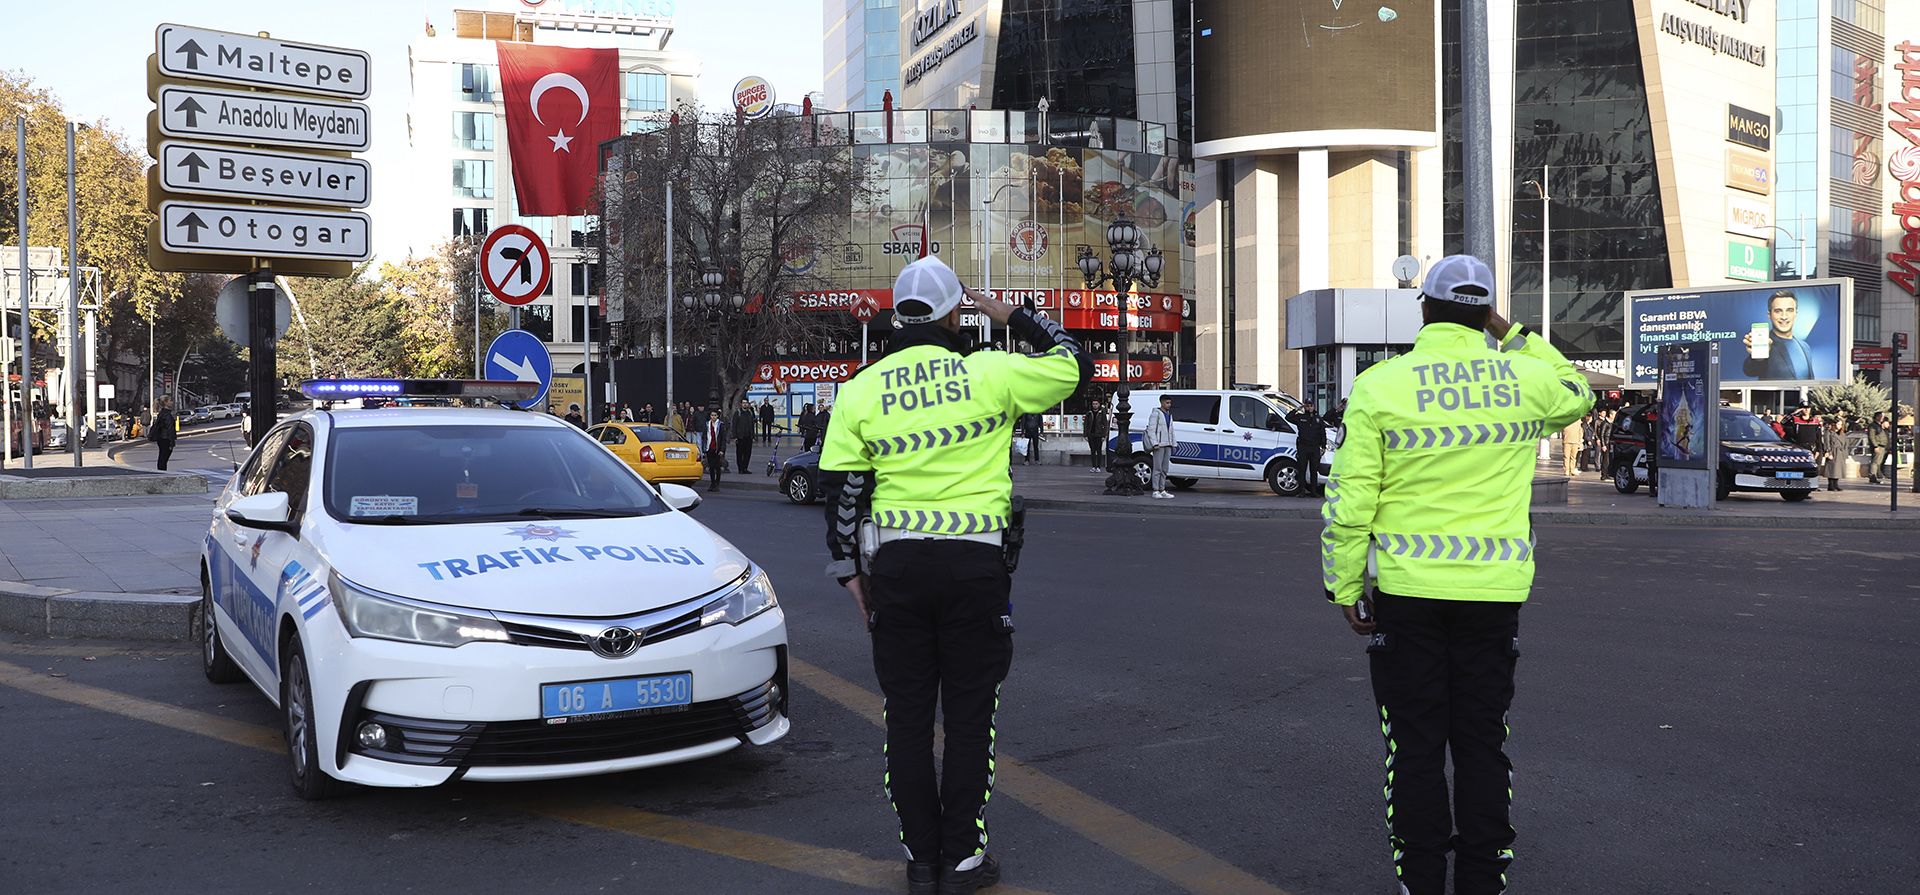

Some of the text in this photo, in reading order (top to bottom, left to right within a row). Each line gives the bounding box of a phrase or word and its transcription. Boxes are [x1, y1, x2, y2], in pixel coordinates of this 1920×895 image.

[217, 44, 353, 85] Maltepe
[737, 84, 766, 100] BURGER
[739, 91, 767, 107] KING
[218, 100, 359, 139] Anadolu Meydanı
[1730, 114, 1769, 139] MANGO
[219, 157, 356, 190] Beşevler
[218, 215, 352, 247] Otogar
[883, 242, 940, 254] SBARO
[799, 292, 858, 308] SBARRO
[858, 307, 872, 317] M
[1100, 313, 1120, 327] UST
[1640, 310, 1708, 322] Garanti BBVA
[1640, 321, 1704, 332] danışmanlığı
[1640, 331, 1737, 342] finansal sağlığınıza
[1711, 342, 1718, 350] 2
[1094, 364, 1142, 378] SBARO
[1585, 359, 1625, 369] COFFE
[417, 544, 705, 581] TRAFİK POLİSİ
[558, 677, 687, 712] 06 A 5530
